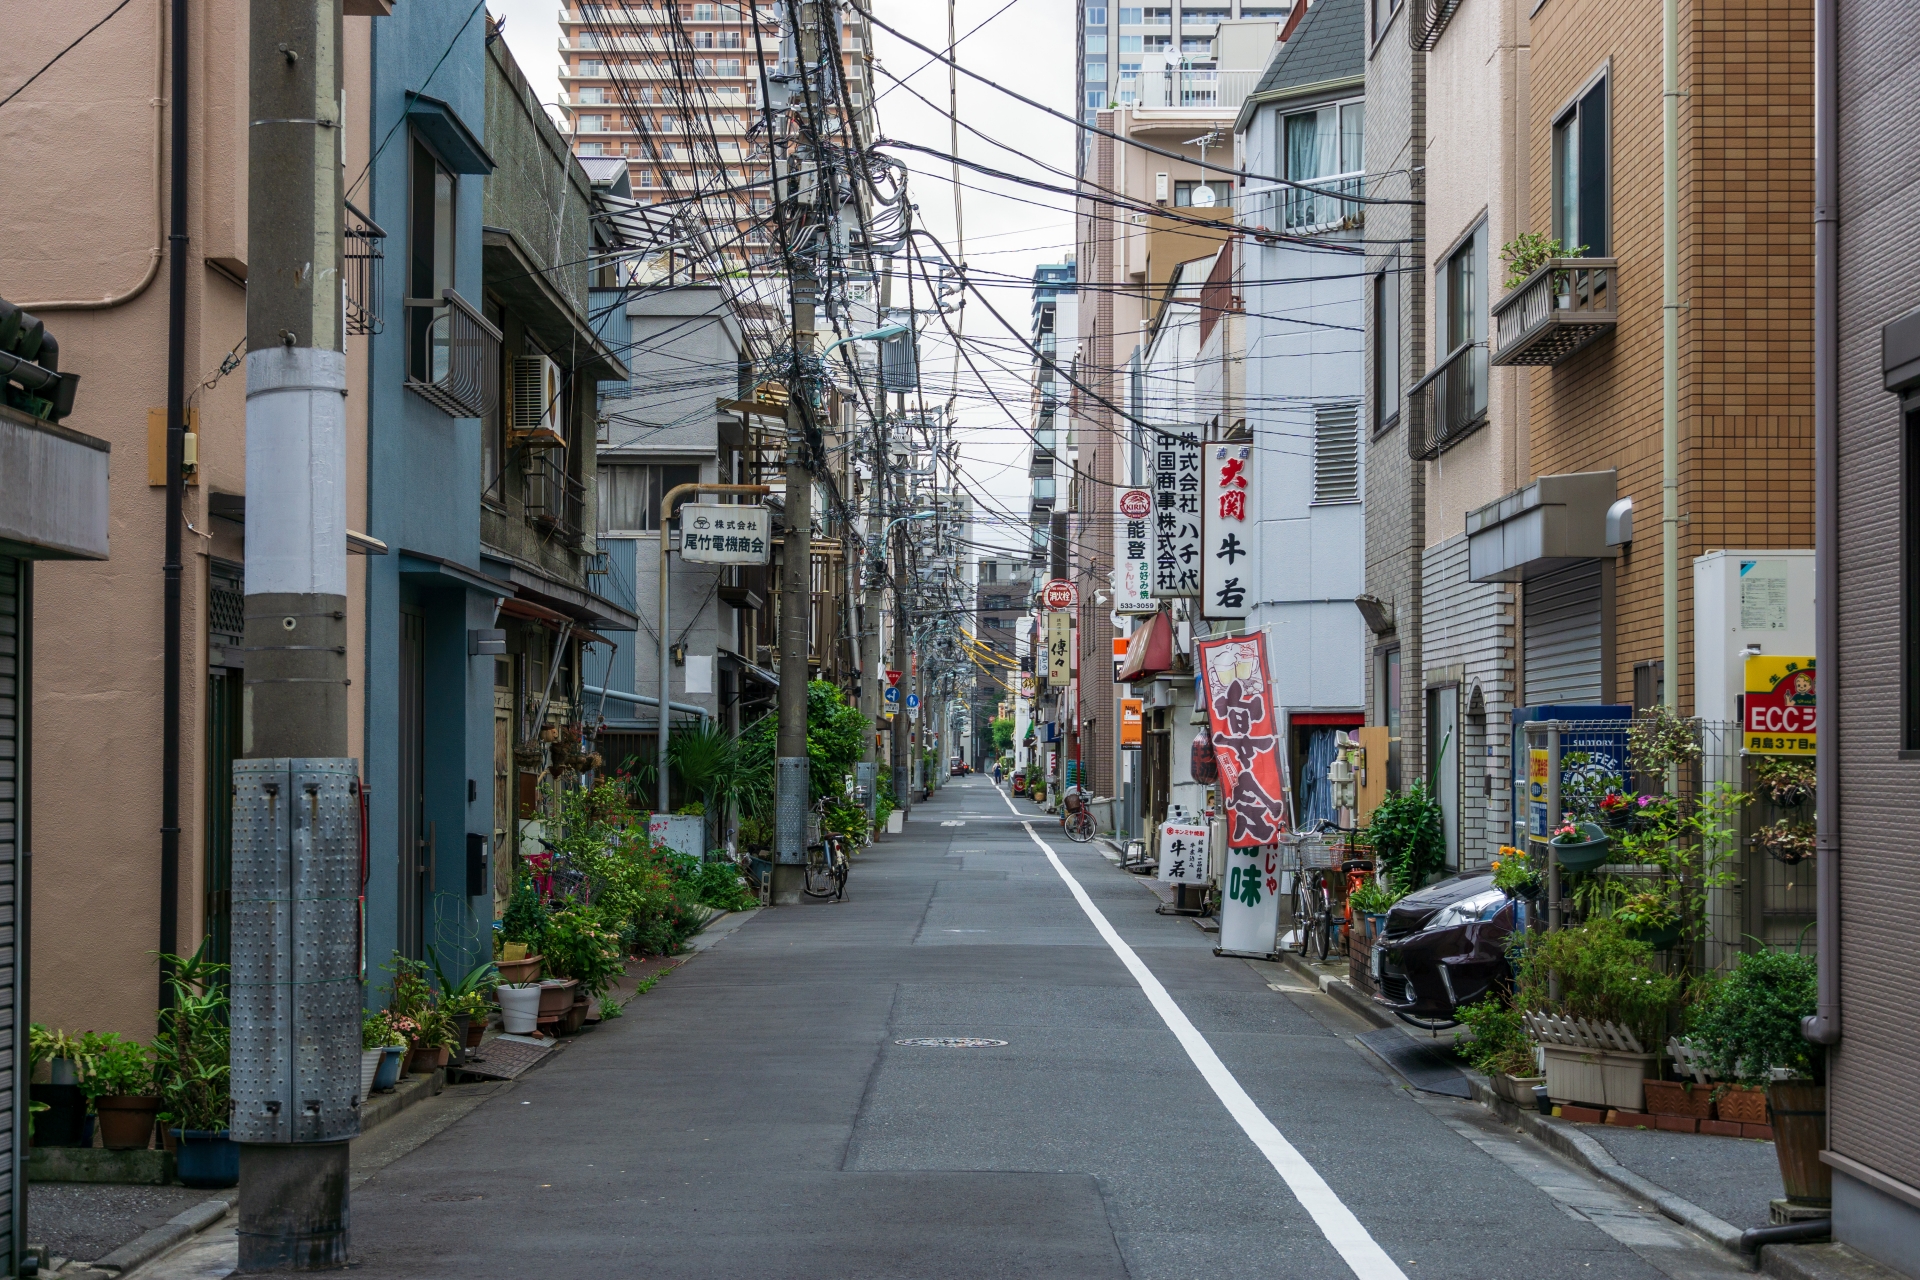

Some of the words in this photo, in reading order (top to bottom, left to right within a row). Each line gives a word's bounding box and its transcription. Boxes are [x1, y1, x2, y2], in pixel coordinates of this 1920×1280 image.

[1126, 503, 1147, 511] KIRIN
[1219, 457, 1248, 522] 大関
[714, 519, 757, 531] 株式会社
[1157, 435, 1176, 590] 中国商事株式会社
[684, 533, 764, 554] 尾竹電機商会
[1127, 520, 1146, 559] 能登
[1140, 562, 1149, 600] お好み焼
[1216, 533, 1246, 608] 牛若
[1049, 591, 1070, 601] 消火栓
[1168, 839, 1187, 878] 牛若
